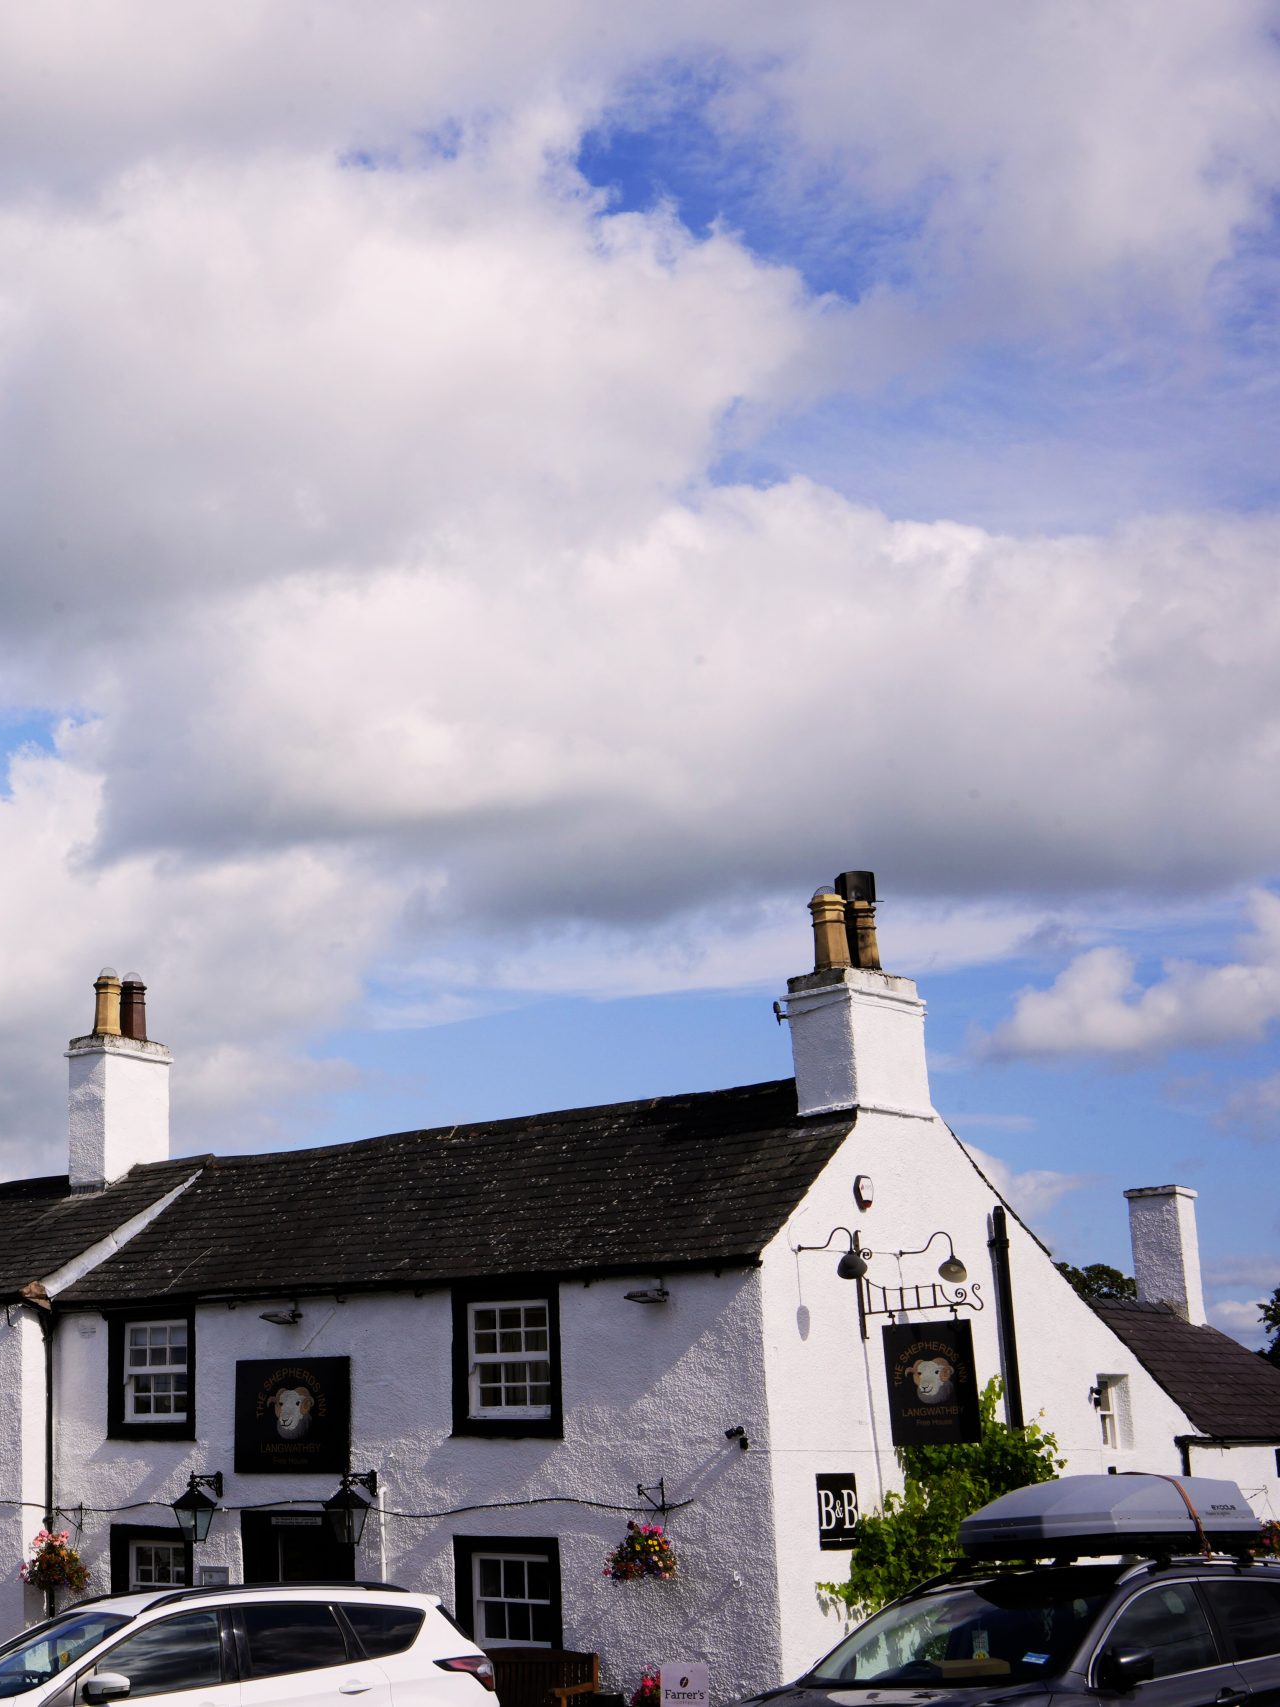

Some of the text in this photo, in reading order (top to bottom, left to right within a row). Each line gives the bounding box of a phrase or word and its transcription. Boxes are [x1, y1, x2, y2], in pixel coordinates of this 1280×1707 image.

[893, 1340, 968, 1387] THE SHEPHERDS INN
[256, 1367, 328, 1417] THE SHEPHERDS INN
[902, 1406, 965, 1417] LANGWATHBY
[260, 1442, 321, 1454] LANGWATHBY
[819, 1489, 858, 1531] B&B
[665, 1689, 705, 1700] Farrer's
